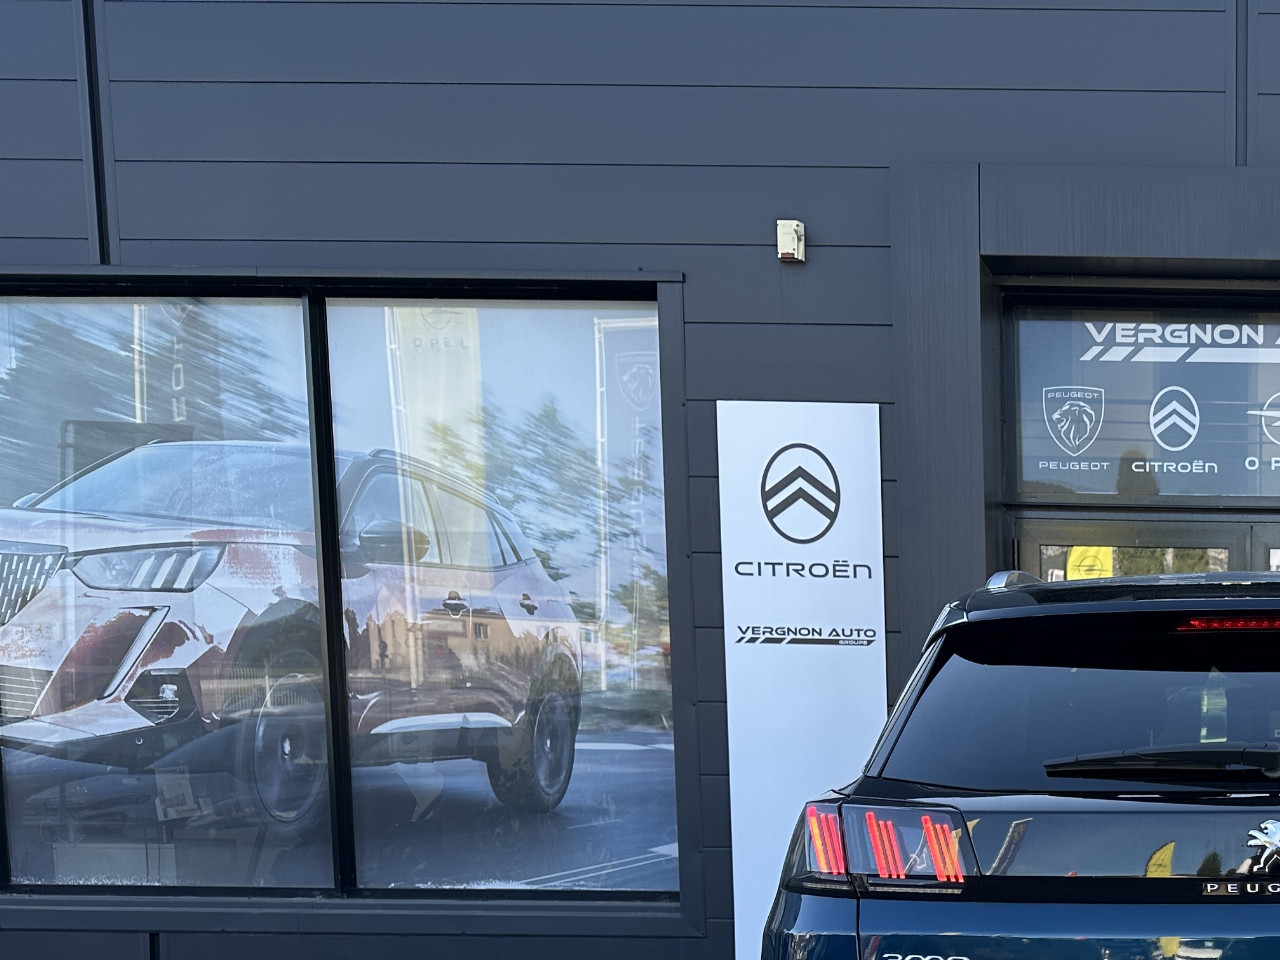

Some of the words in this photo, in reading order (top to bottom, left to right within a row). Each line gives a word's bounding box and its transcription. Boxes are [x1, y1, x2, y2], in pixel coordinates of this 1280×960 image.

[1084, 322, 1264, 345] VERGNON
[1047, 391, 1099, 400] PEUGEOT
[1039, 461, 1110, 470] PEUGEOT
[1131, 460, 1218, 473] CITROËN
[734, 560, 872, 579] CITROËN
[737, 625, 822, 637] VERGNON
[828, 627, 877, 638] AUTO
